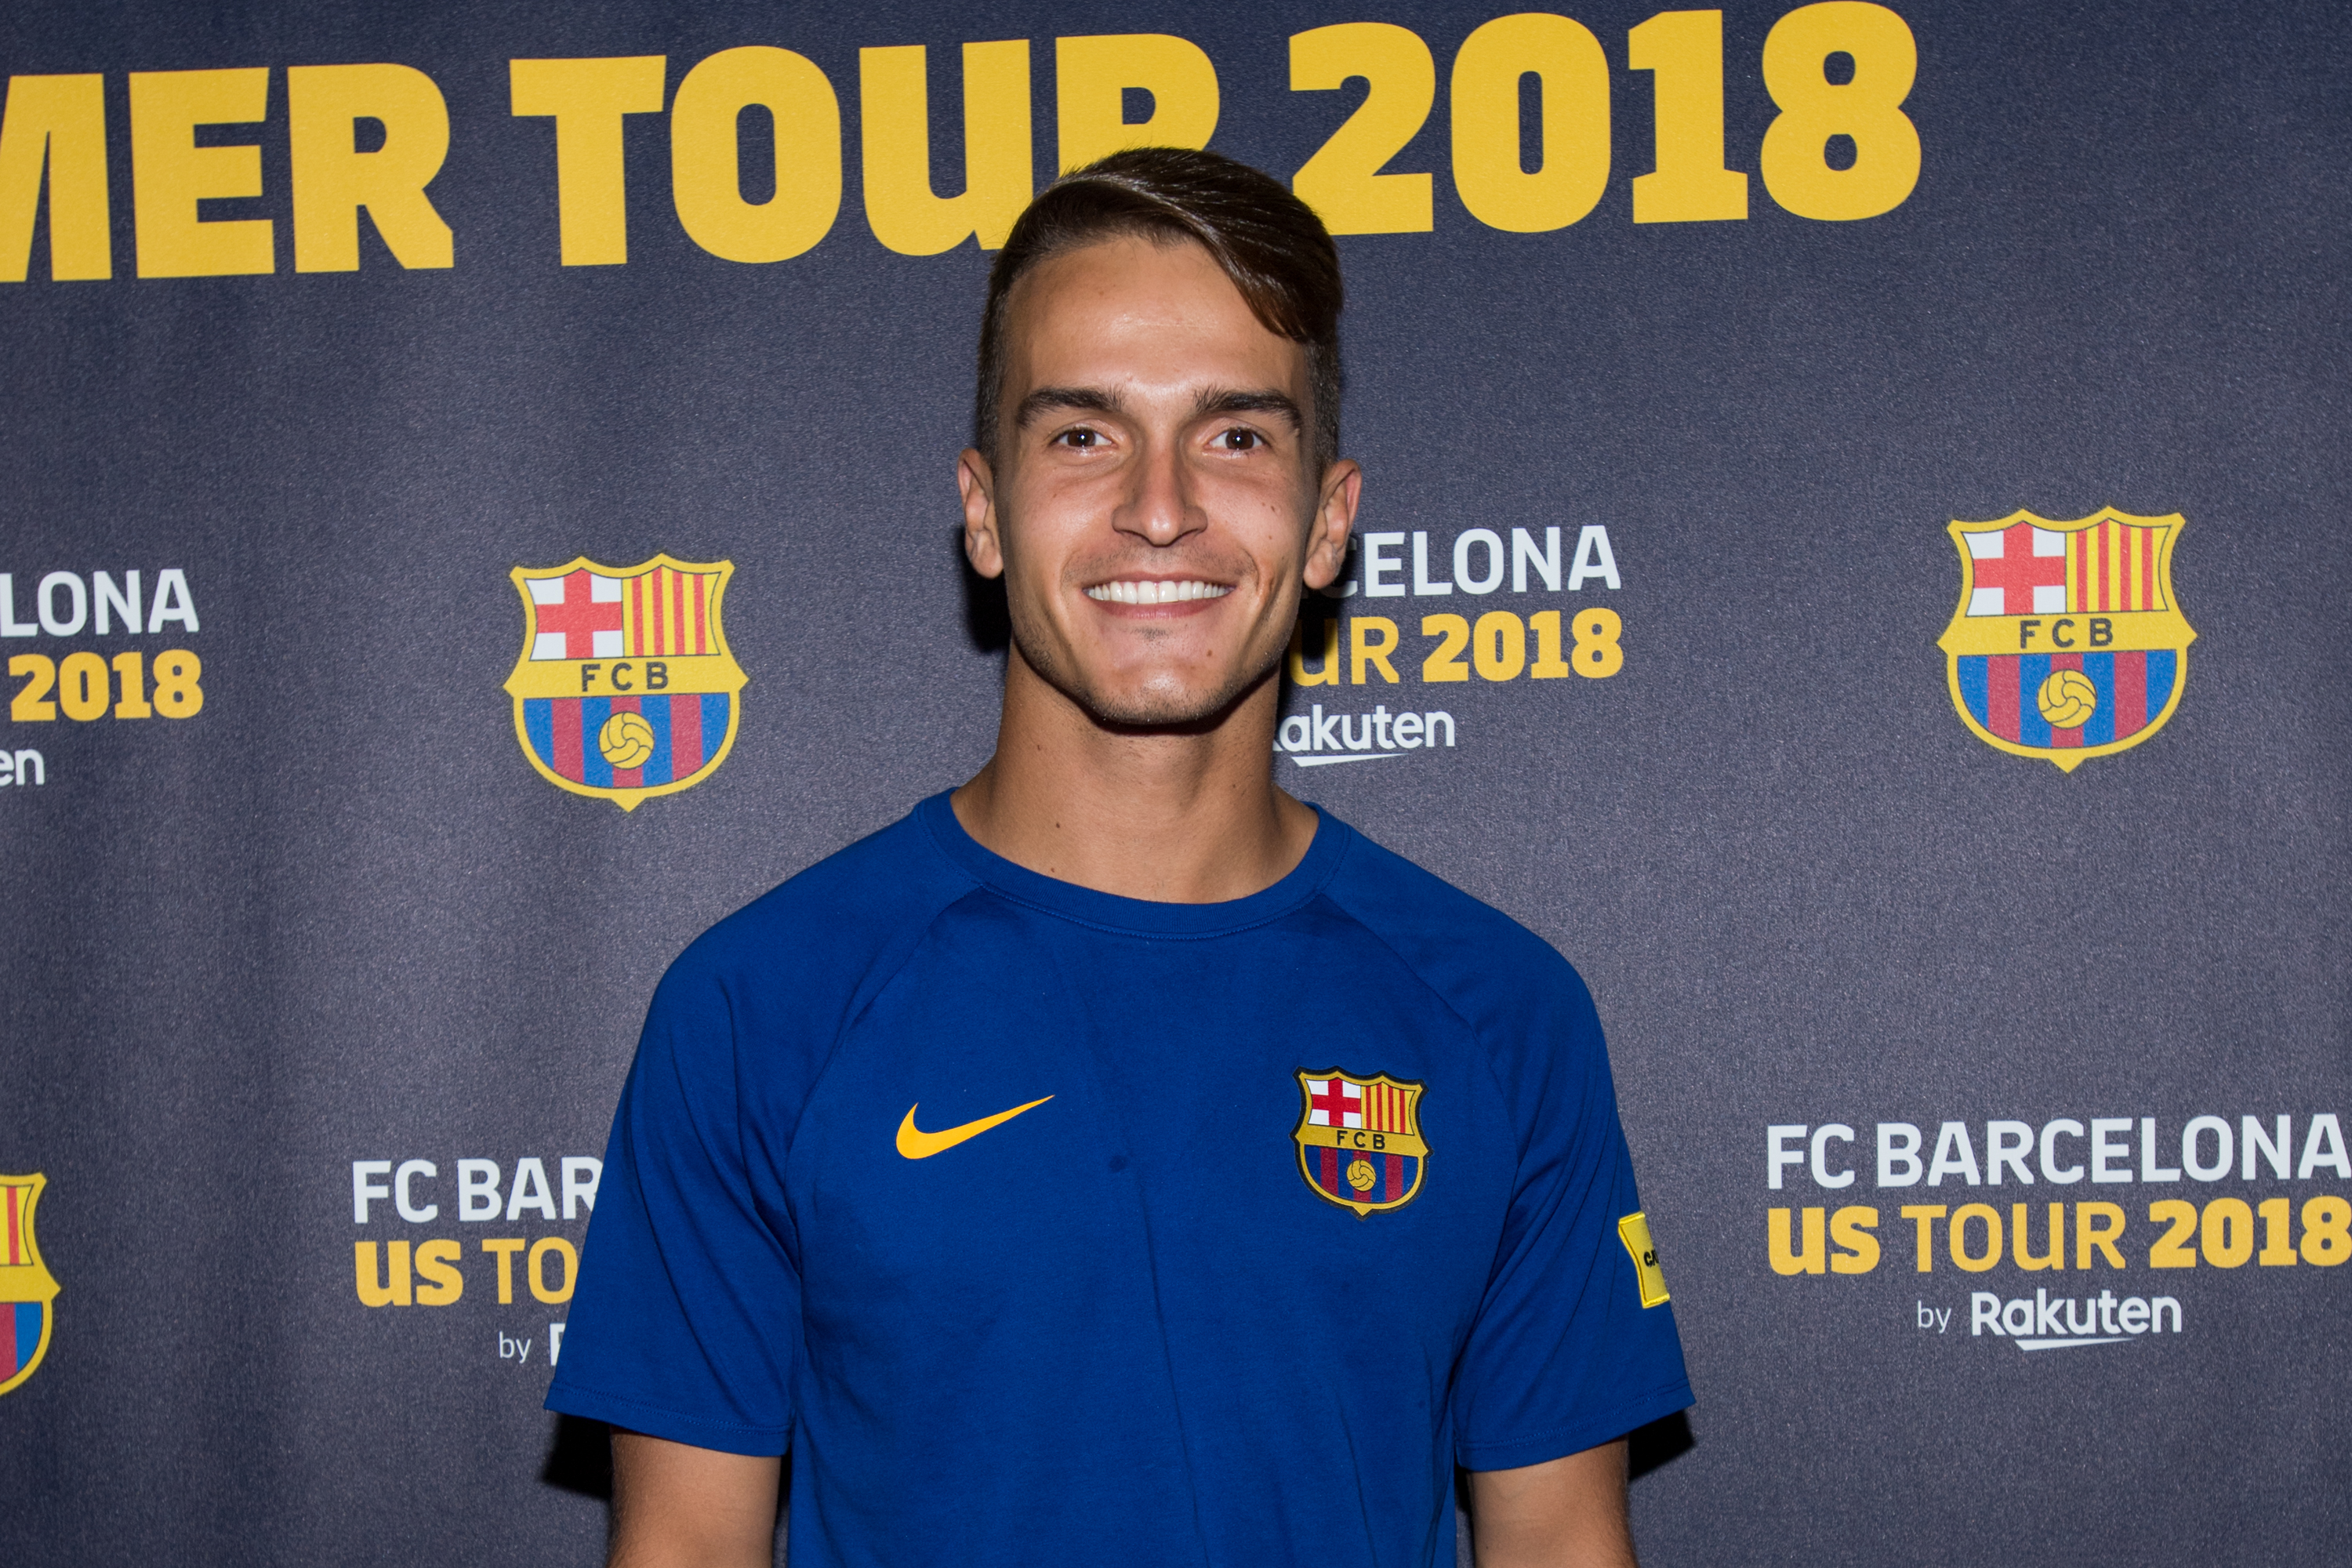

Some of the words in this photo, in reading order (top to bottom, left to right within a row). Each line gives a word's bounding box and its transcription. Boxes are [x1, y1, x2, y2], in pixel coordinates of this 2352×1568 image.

[509, 33, 1220, 267] TOUR
[1289, 1, 1922, 235] 2018
[0, 568, 200, 637] LONA
[2020, 618, 2114, 650] FCB
[581, 661, 669, 692] FCB
[1421, 608, 1624, 683] 2018
[9, 648, 204, 722] 2018
[1272, 704, 1456, 753] akuten
[1336, 1130, 1385, 1150] FCB
[1767, 1123, 1856, 1190] FC
[1876, 1113, 2352, 1188] BARCELONA
[352, 1159, 438, 1224] FC
[457, 1156, 604, 1222] BAR
[1768, 1206, 1881, 1276] US
[1900, 1201, 2126, 1273] TOUR
[2149, 1196, 2352, 1269] 2018
[354, 1239, 463, 1307] US
[481, 1236, 579, 1305] TO
[1917, 1300, 1952, 1334] by
[1971, 1287, 2183, 1338] Rakuten
[499, 1330, 532, 1364] by
